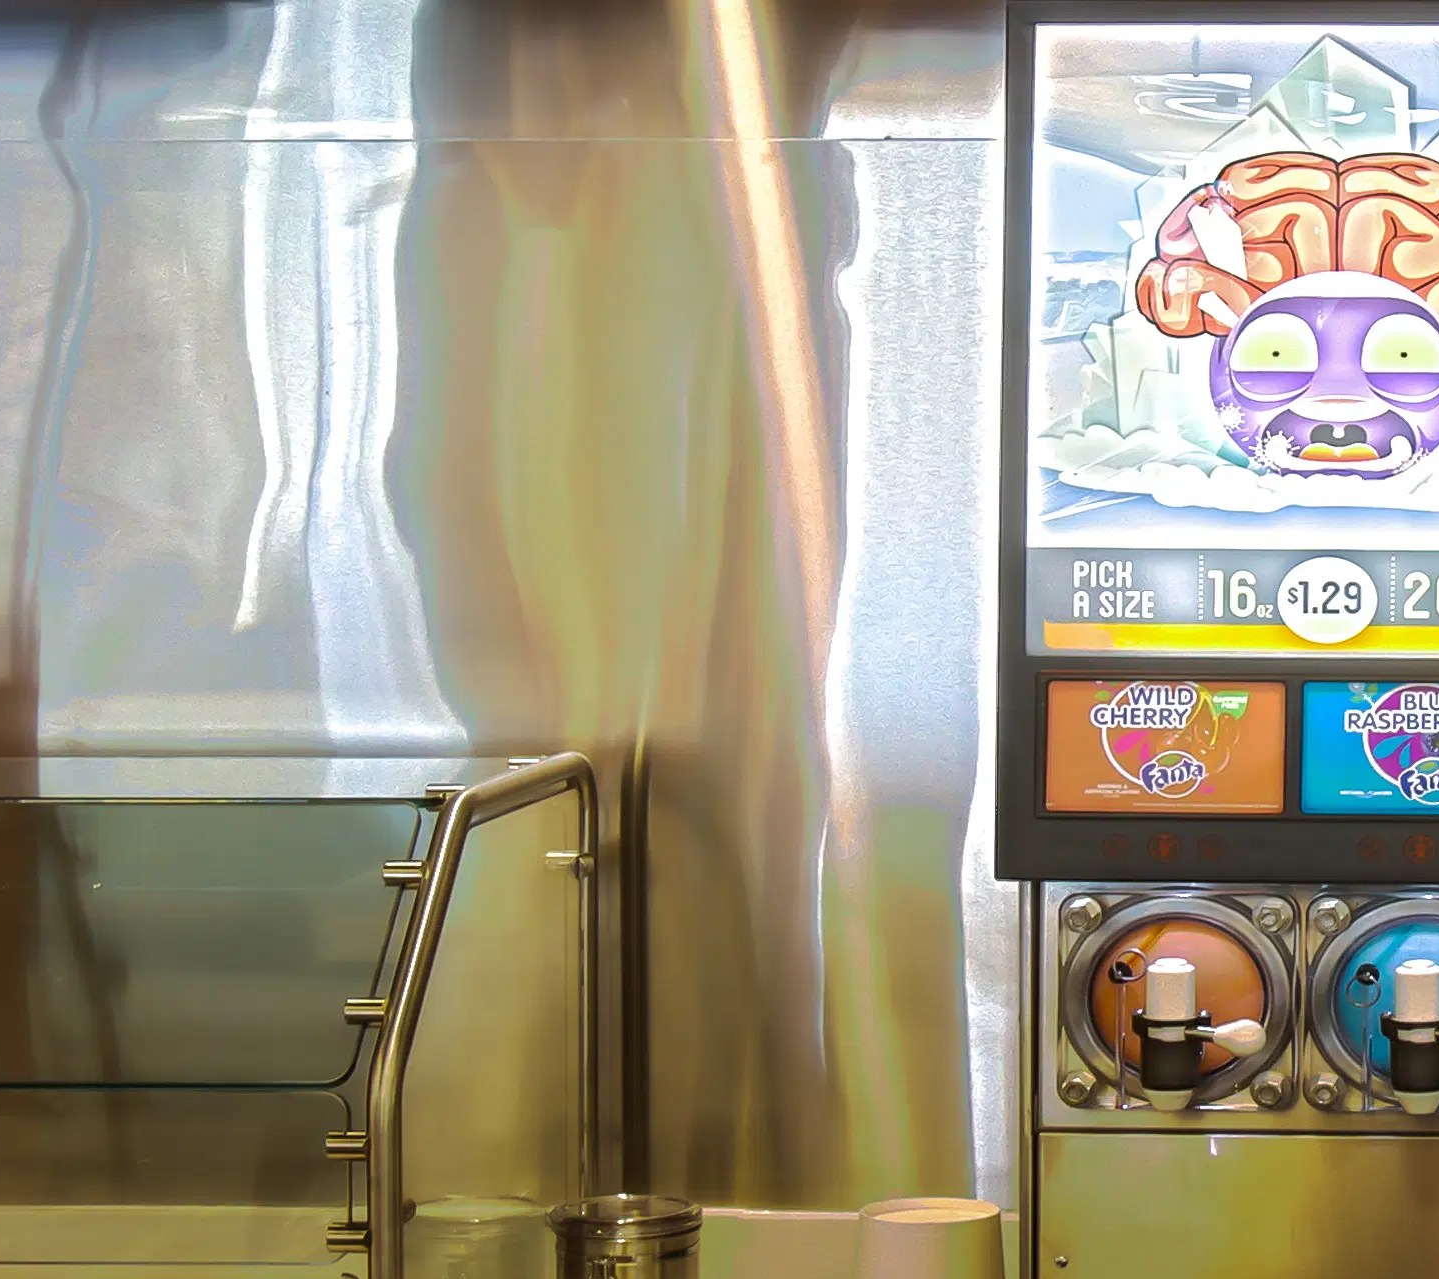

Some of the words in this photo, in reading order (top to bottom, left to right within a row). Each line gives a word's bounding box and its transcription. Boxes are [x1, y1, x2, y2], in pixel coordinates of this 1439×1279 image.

[1073, 561, 1132, 588] PICK
[1073, 591, 1090, 618] A
[1100, 591, 1154, 618] SIZE
[1207, 569, 1257, 618] 16
[1288, 581, 1362, 615] $1.29
[1130, 688, 1194, 705] WILD
[1093, 708, 1189, 726] CHERRY
[1141, 759, 1204, 793] Fanta
